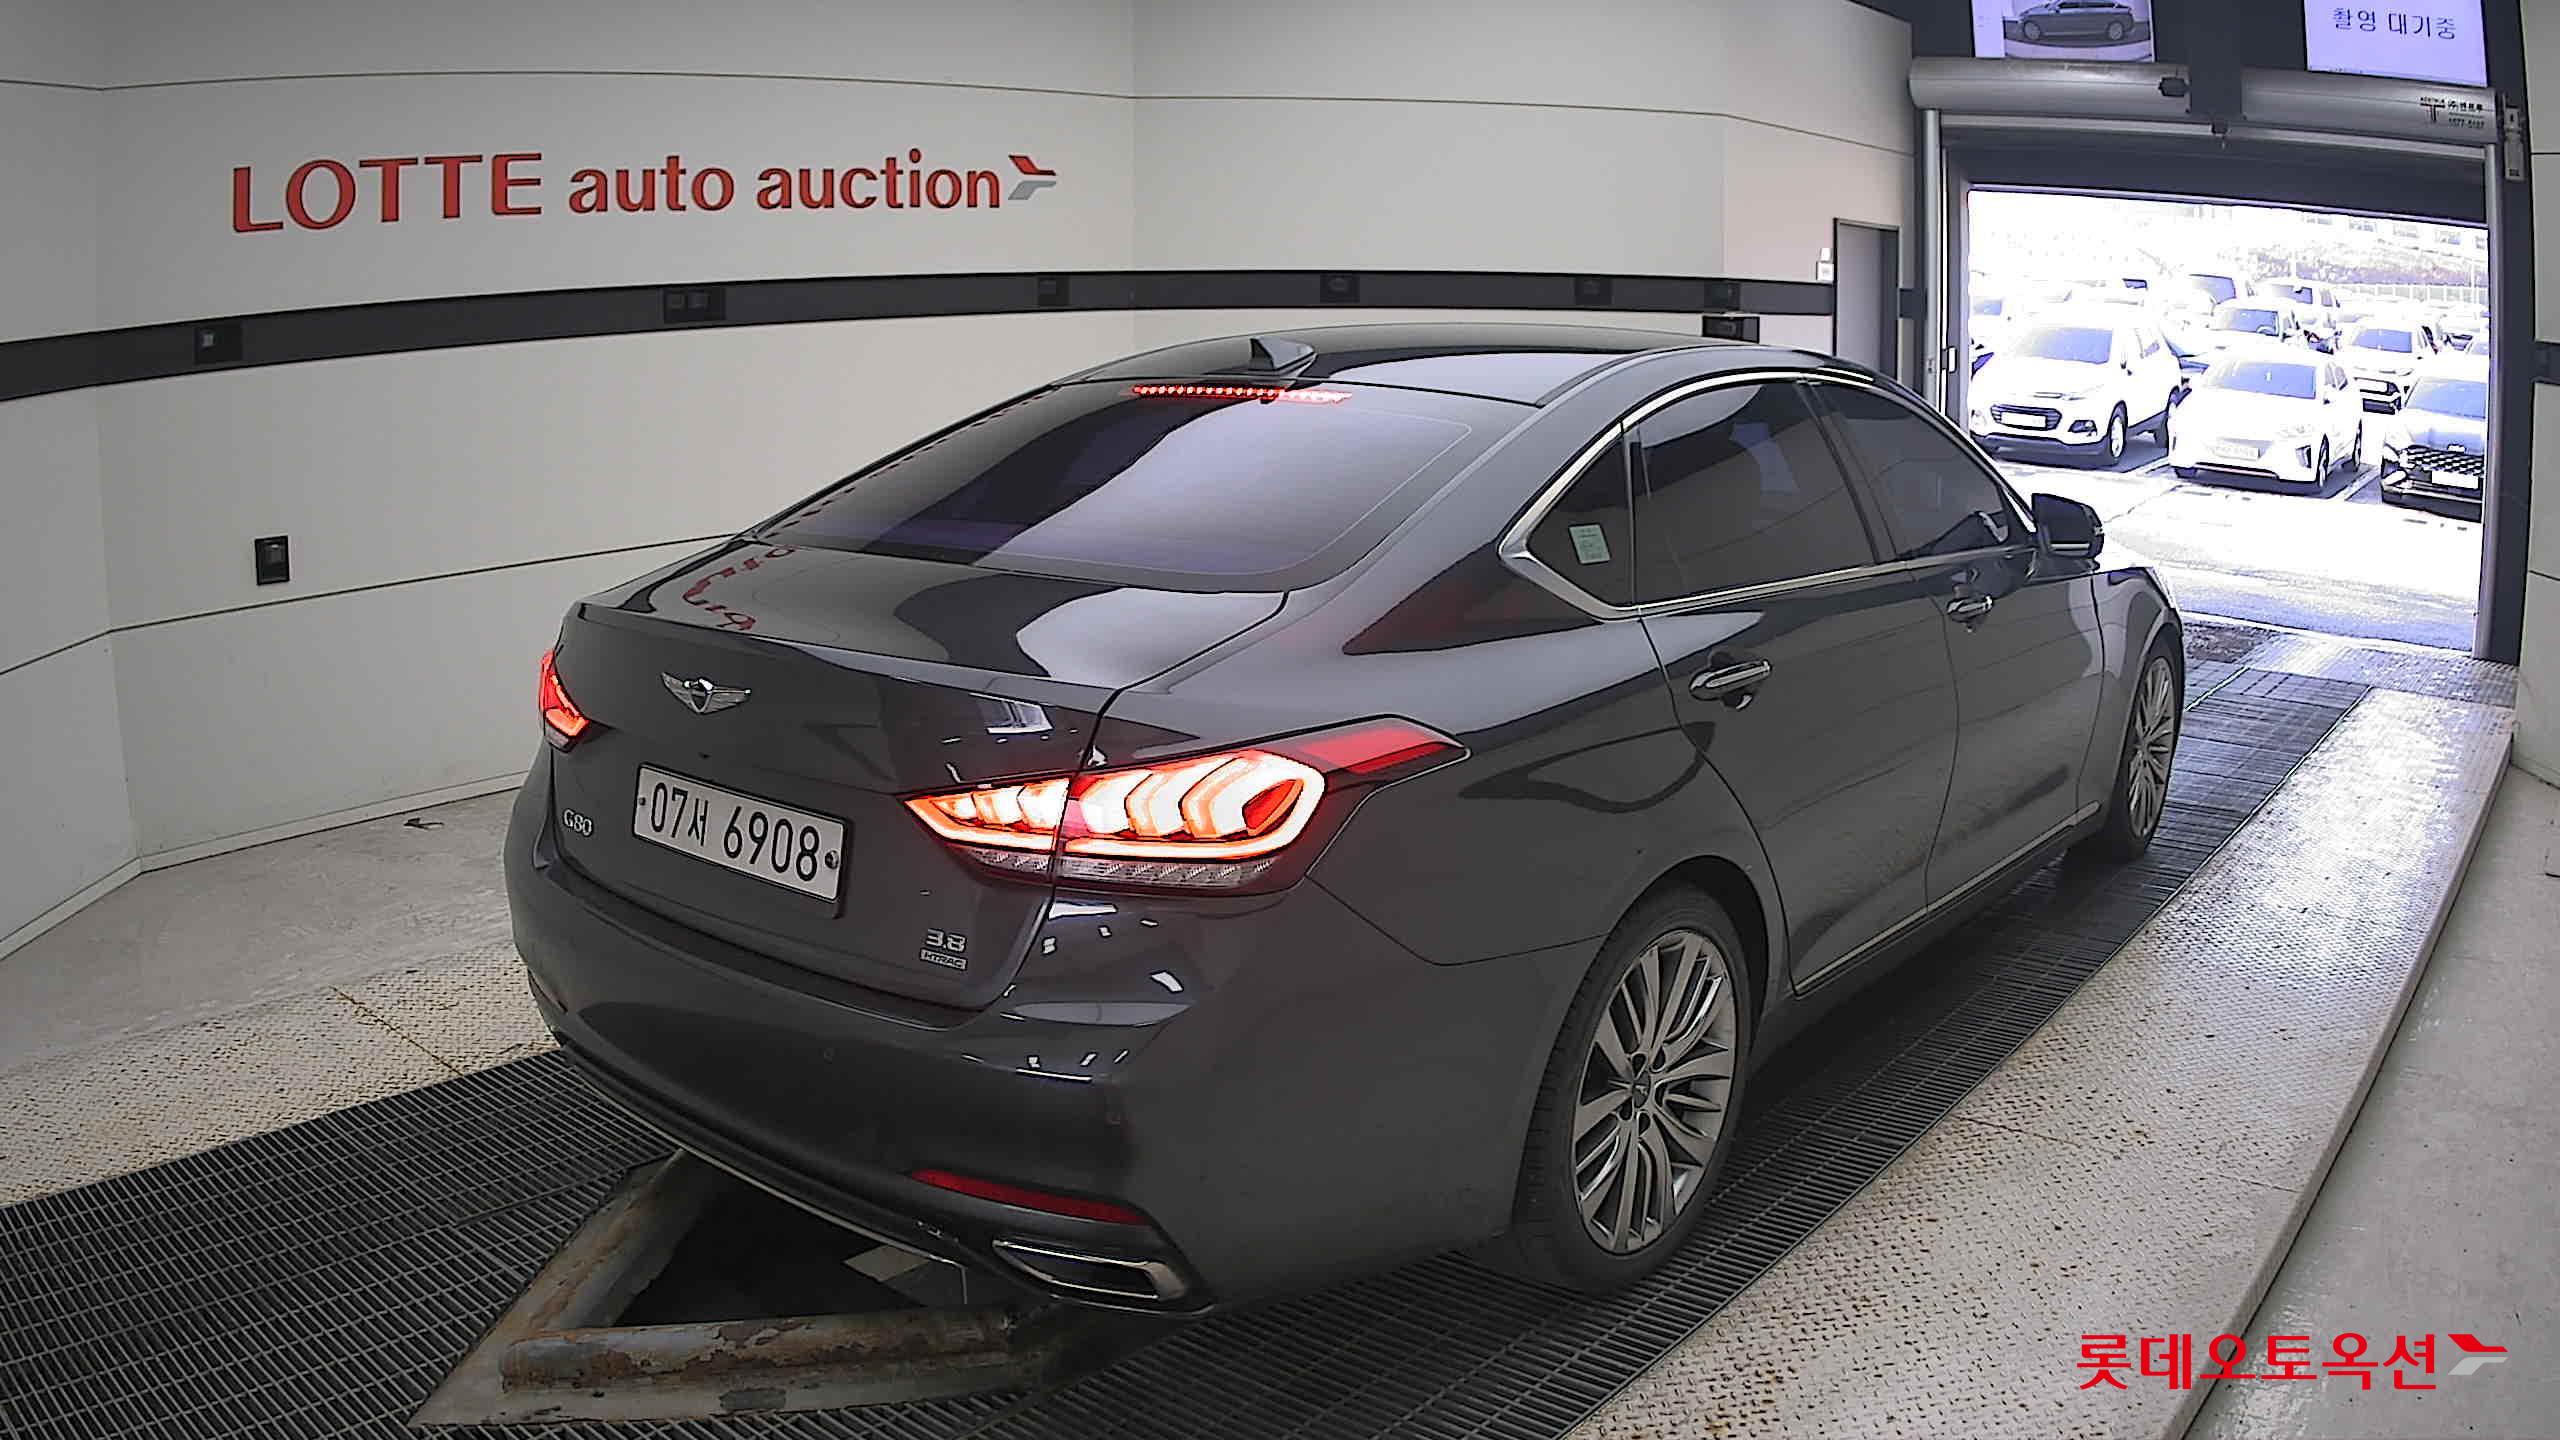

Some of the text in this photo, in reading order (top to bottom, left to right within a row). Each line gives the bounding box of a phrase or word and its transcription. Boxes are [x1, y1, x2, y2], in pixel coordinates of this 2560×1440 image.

[2333, 7, 2456, 40] 촬영 대기중
[234, 147, 1002, 233] LOTTE auto auction
[563, 808, 593, 836] G80
[650, 782, 820, 882] 07서 6908
[926, 928, 966, 952] 3.8
